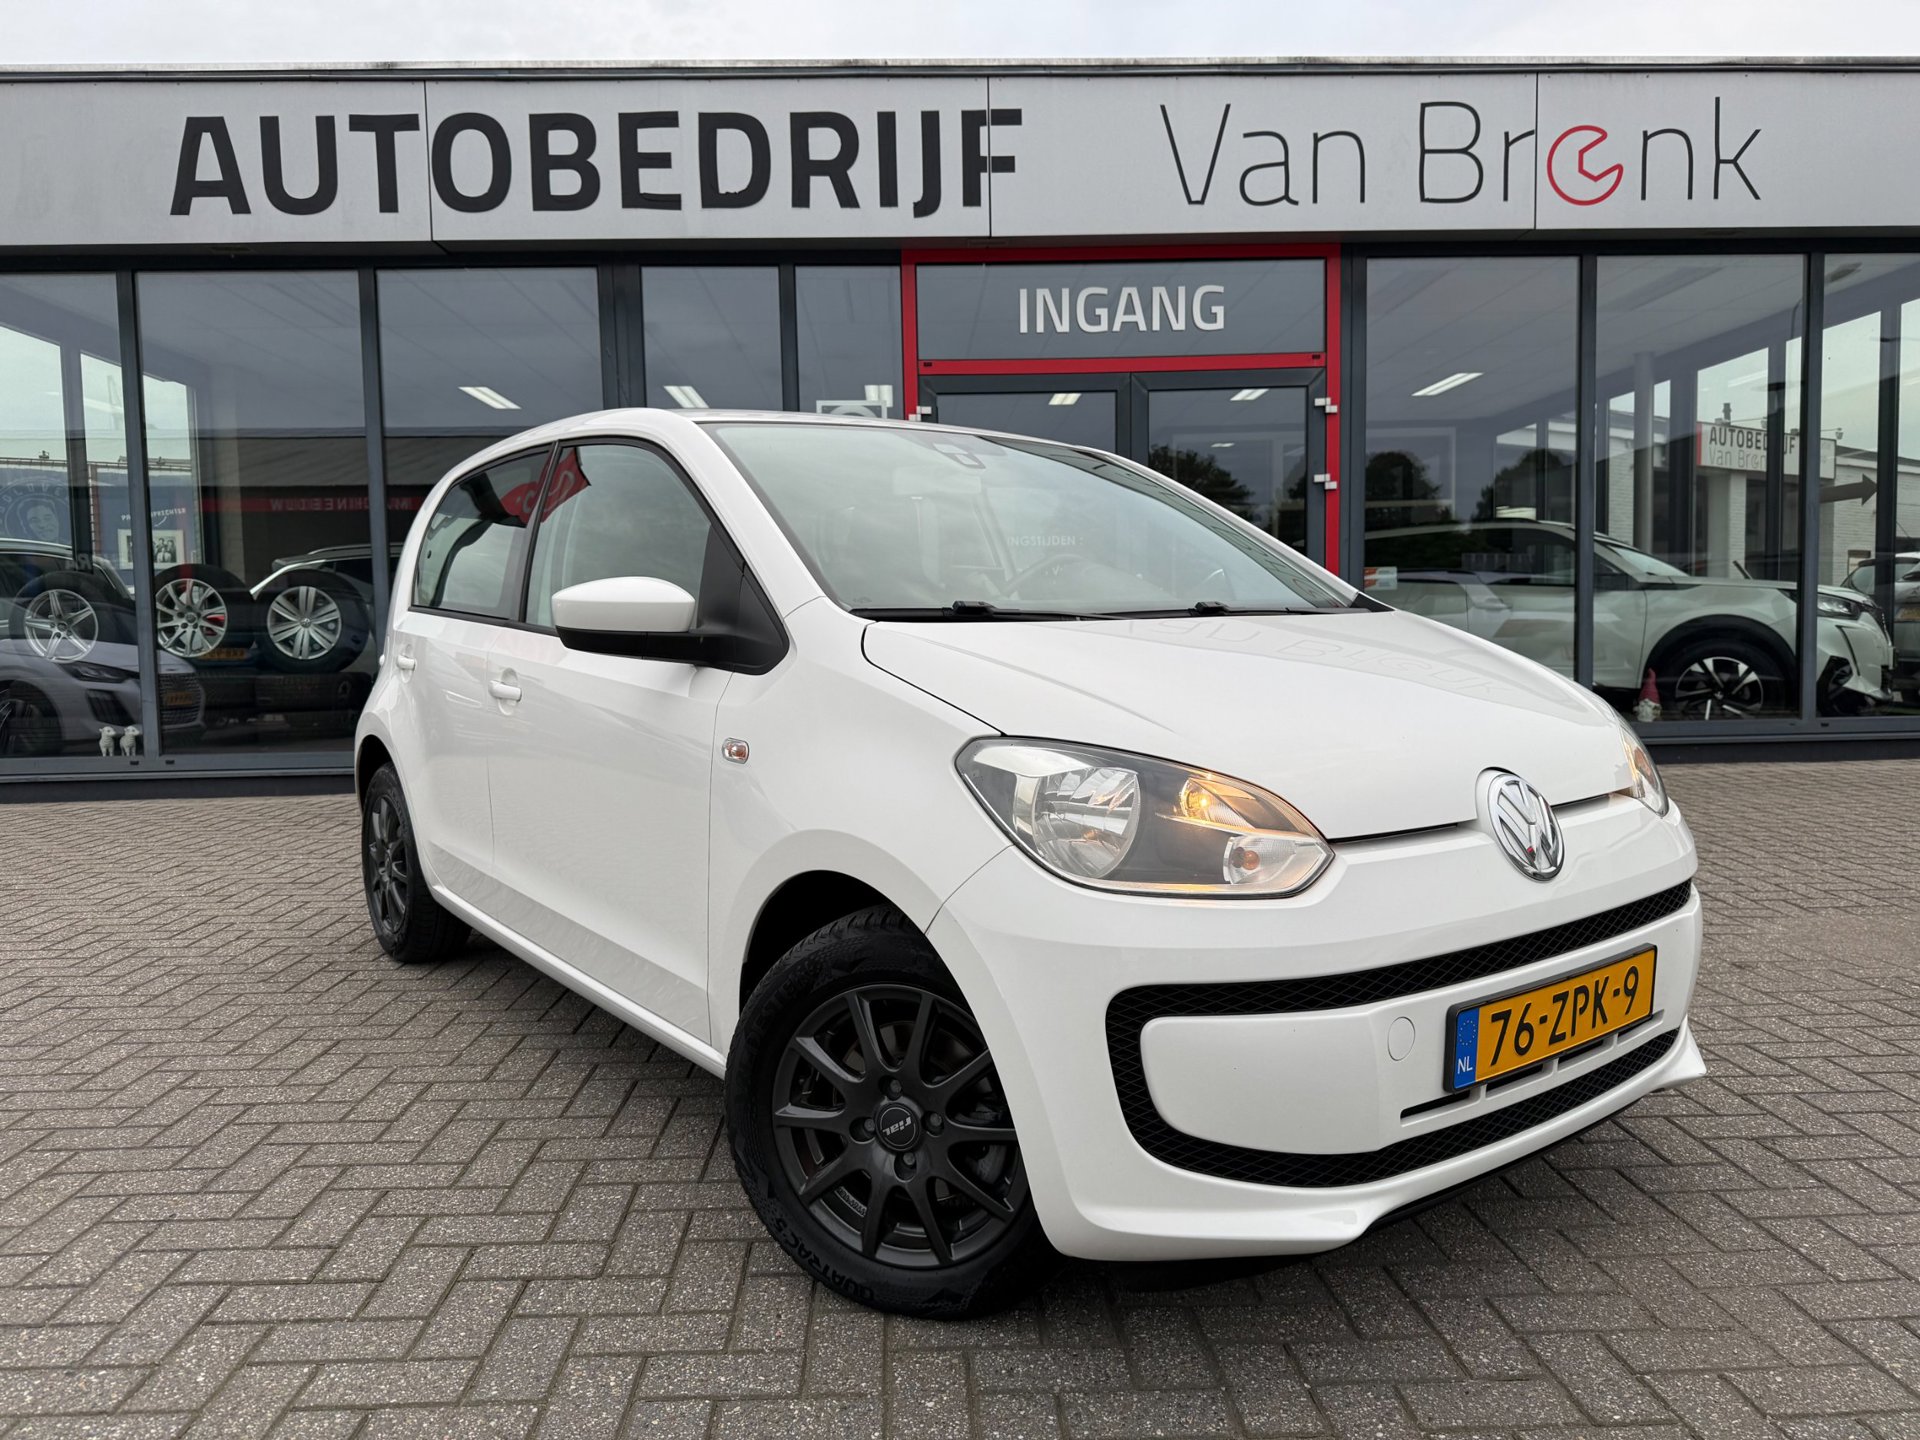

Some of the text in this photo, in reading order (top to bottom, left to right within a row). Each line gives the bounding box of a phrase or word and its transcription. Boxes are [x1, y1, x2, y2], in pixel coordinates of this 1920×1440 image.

[169, 108, 1022, 218] AUTOBEDRIJF
[1159, 102, 1366, 207] Van
[1019, 285, 1225, 334] INGANG
[1709, 426, 1796, 455] AUTOBEJF
[1737, 449, 1768, 470] Bron
[1490, 965, 1640, 1067] 76-ZPK-9
[1457, 1056, 1474, 1075] NL
